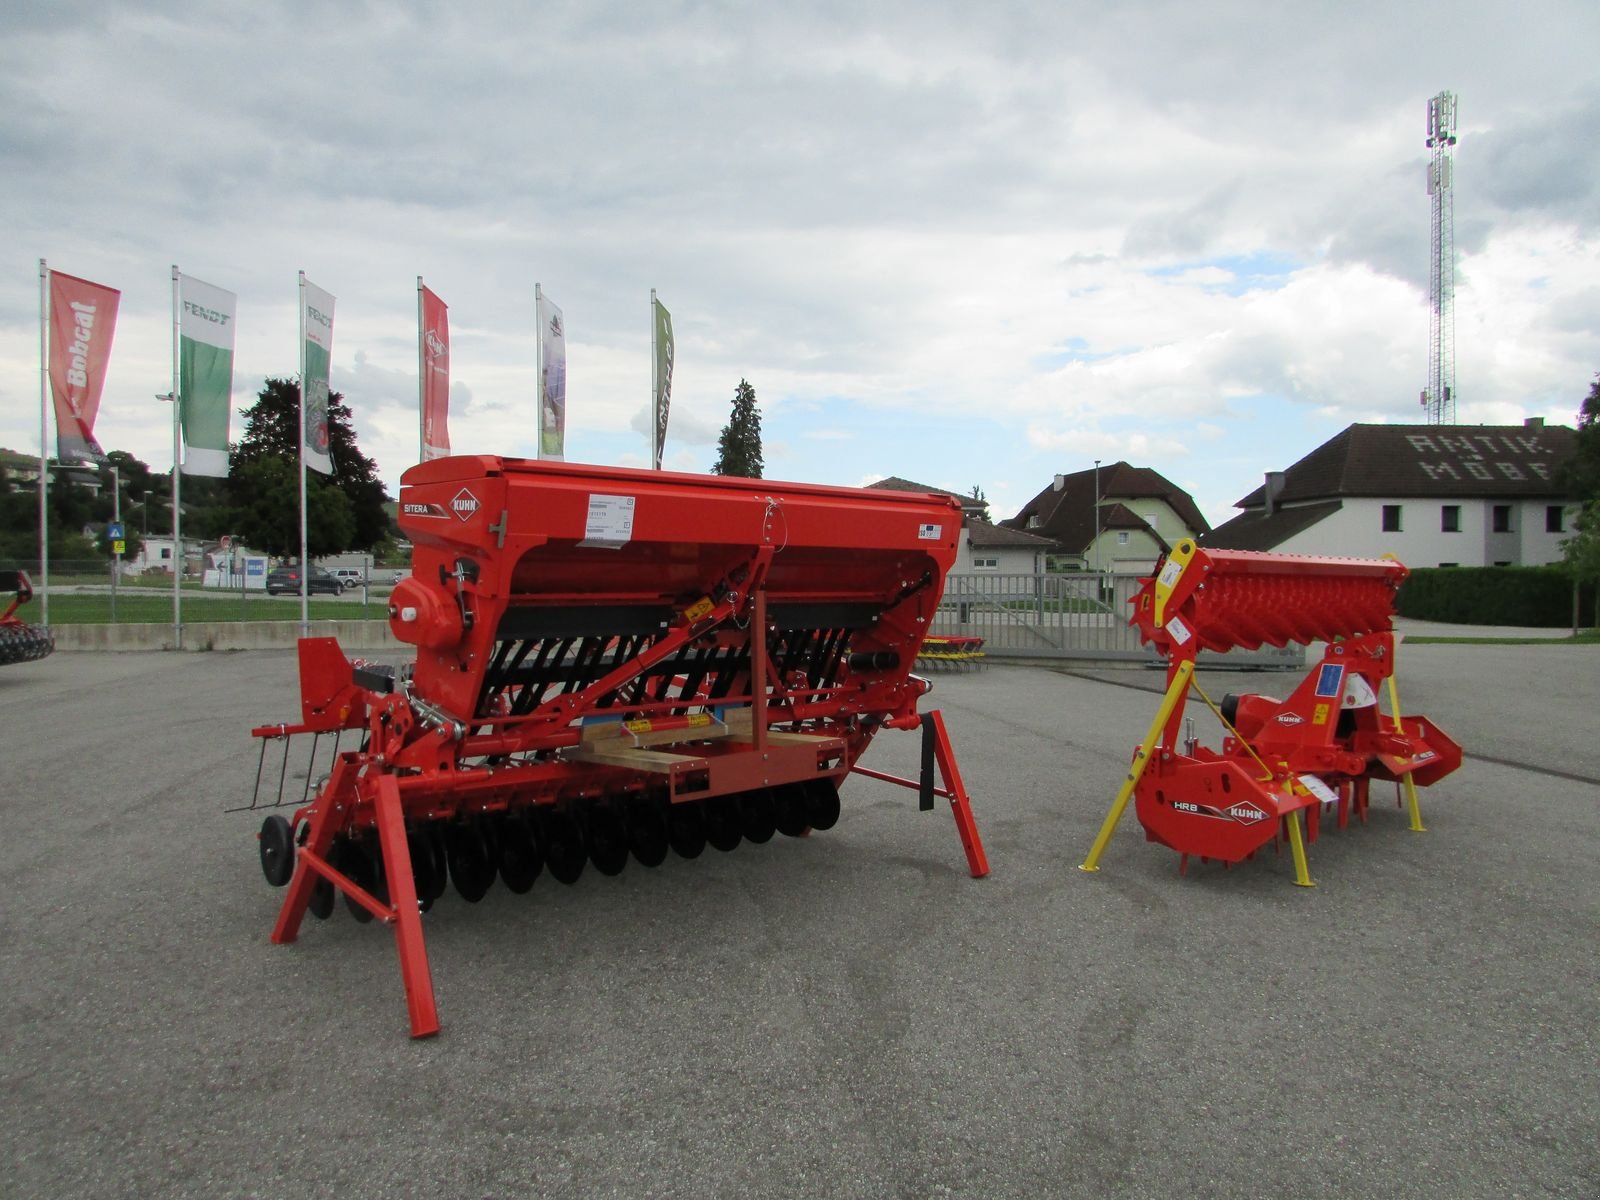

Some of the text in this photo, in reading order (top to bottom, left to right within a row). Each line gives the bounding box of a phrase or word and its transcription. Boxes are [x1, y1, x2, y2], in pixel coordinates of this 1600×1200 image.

[184, 300, 231, 325] FENDT
[67, 300, 97, 388] Bobcat
[404, 503, 429, 513] SITERA
[453, 499, 477, 511] KUHN
[1278, 716, 1302, 724] KUHN
[1230, 807, 1263, 820] KUHN
